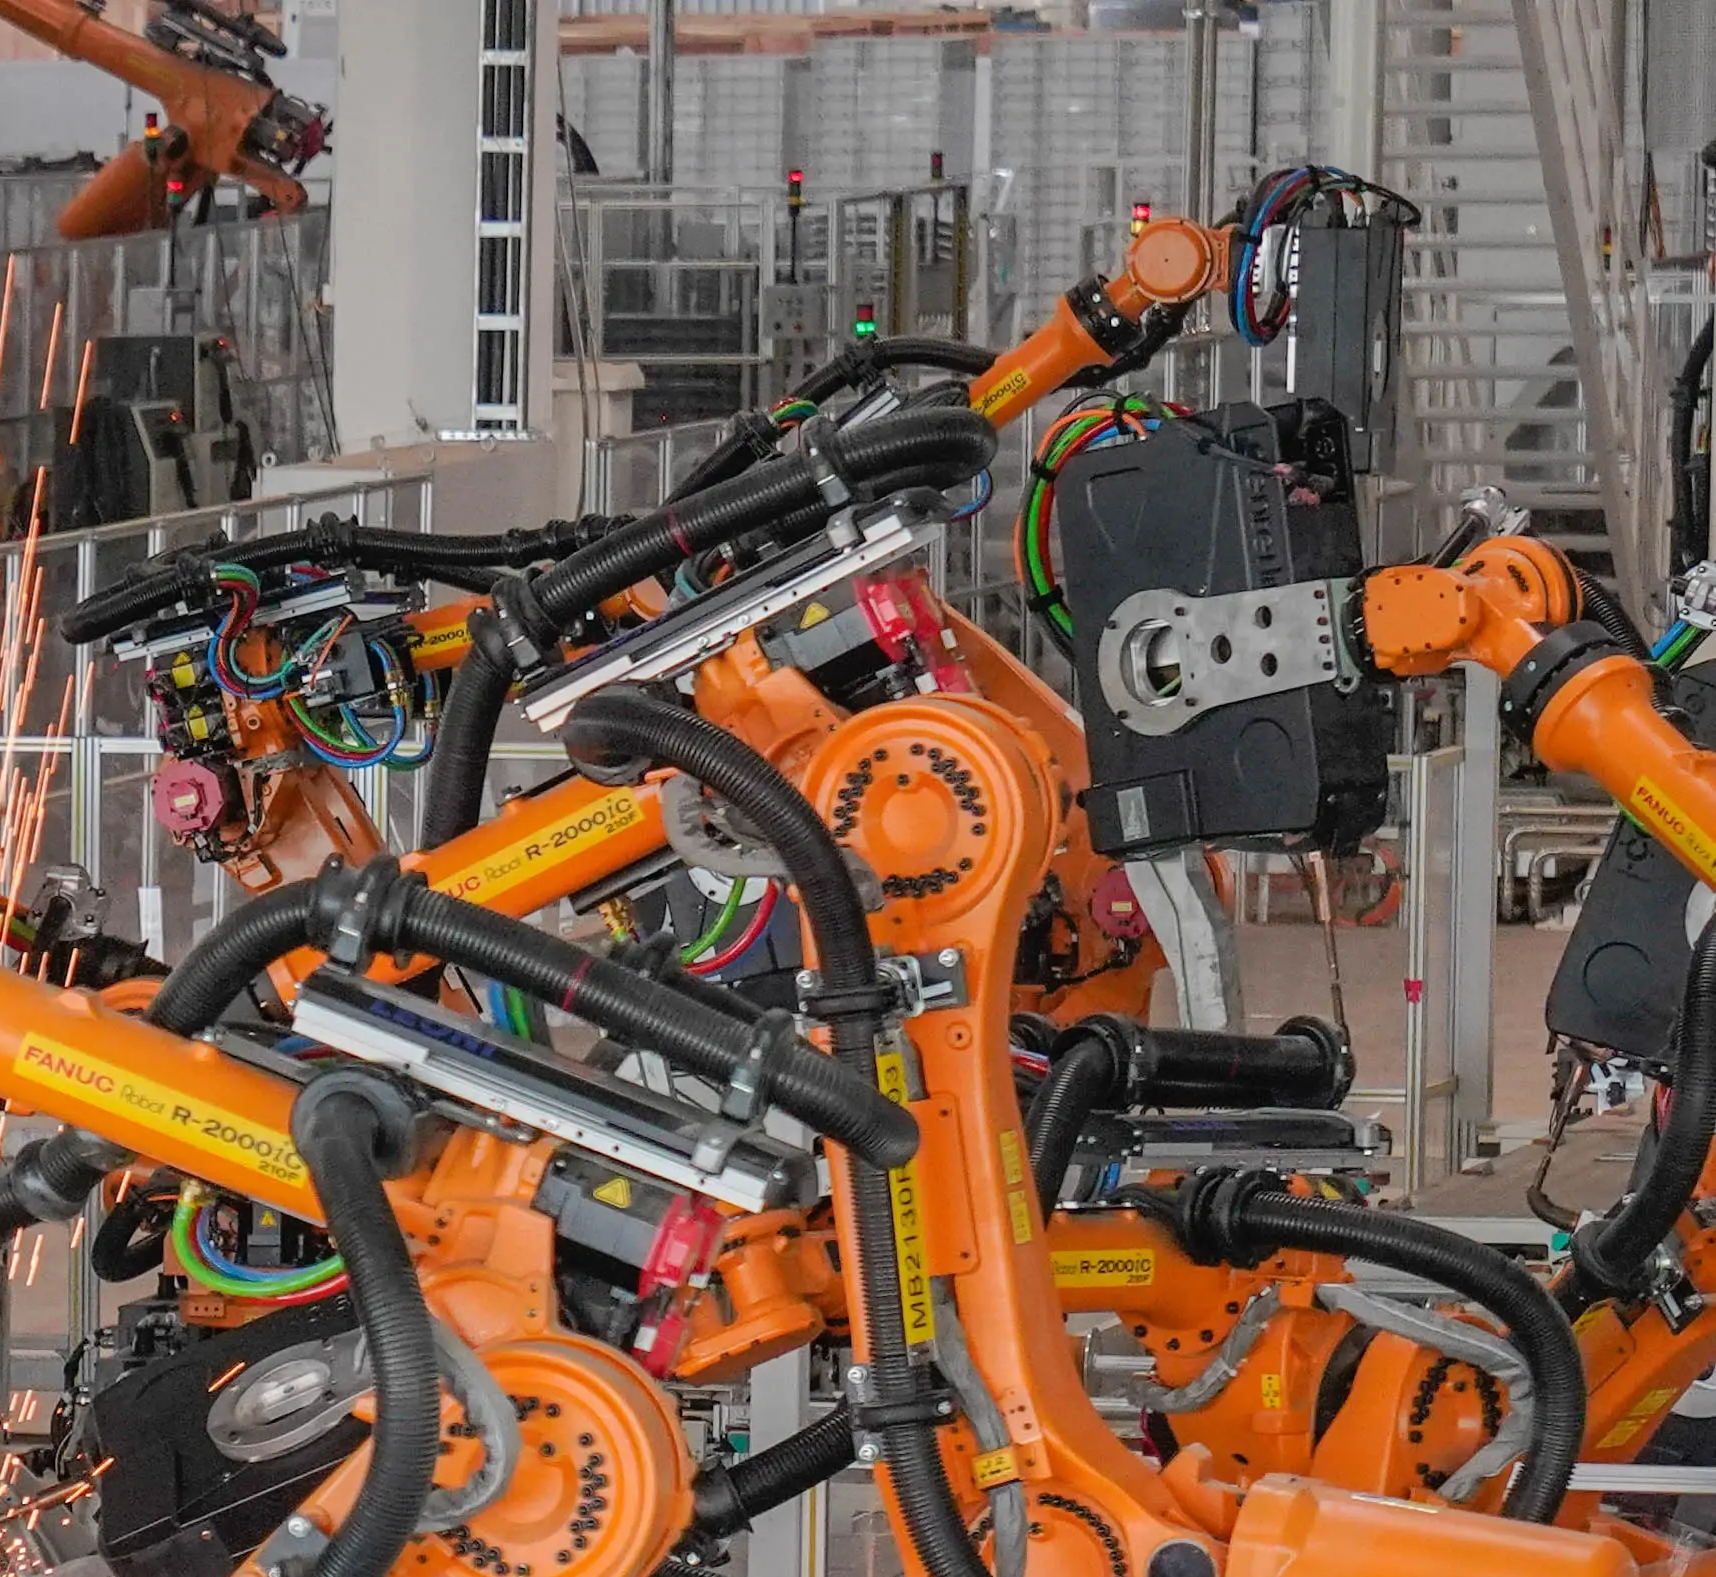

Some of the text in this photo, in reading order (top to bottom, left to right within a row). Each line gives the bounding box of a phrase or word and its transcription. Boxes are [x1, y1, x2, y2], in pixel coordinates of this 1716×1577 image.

[526, 799, 633, 861] R-2000iC
[23, 1045, 115, 1094] FANUC
[119, 1083, 167, 1116] Robot
[258, 1160, 302, 1183] 210F
